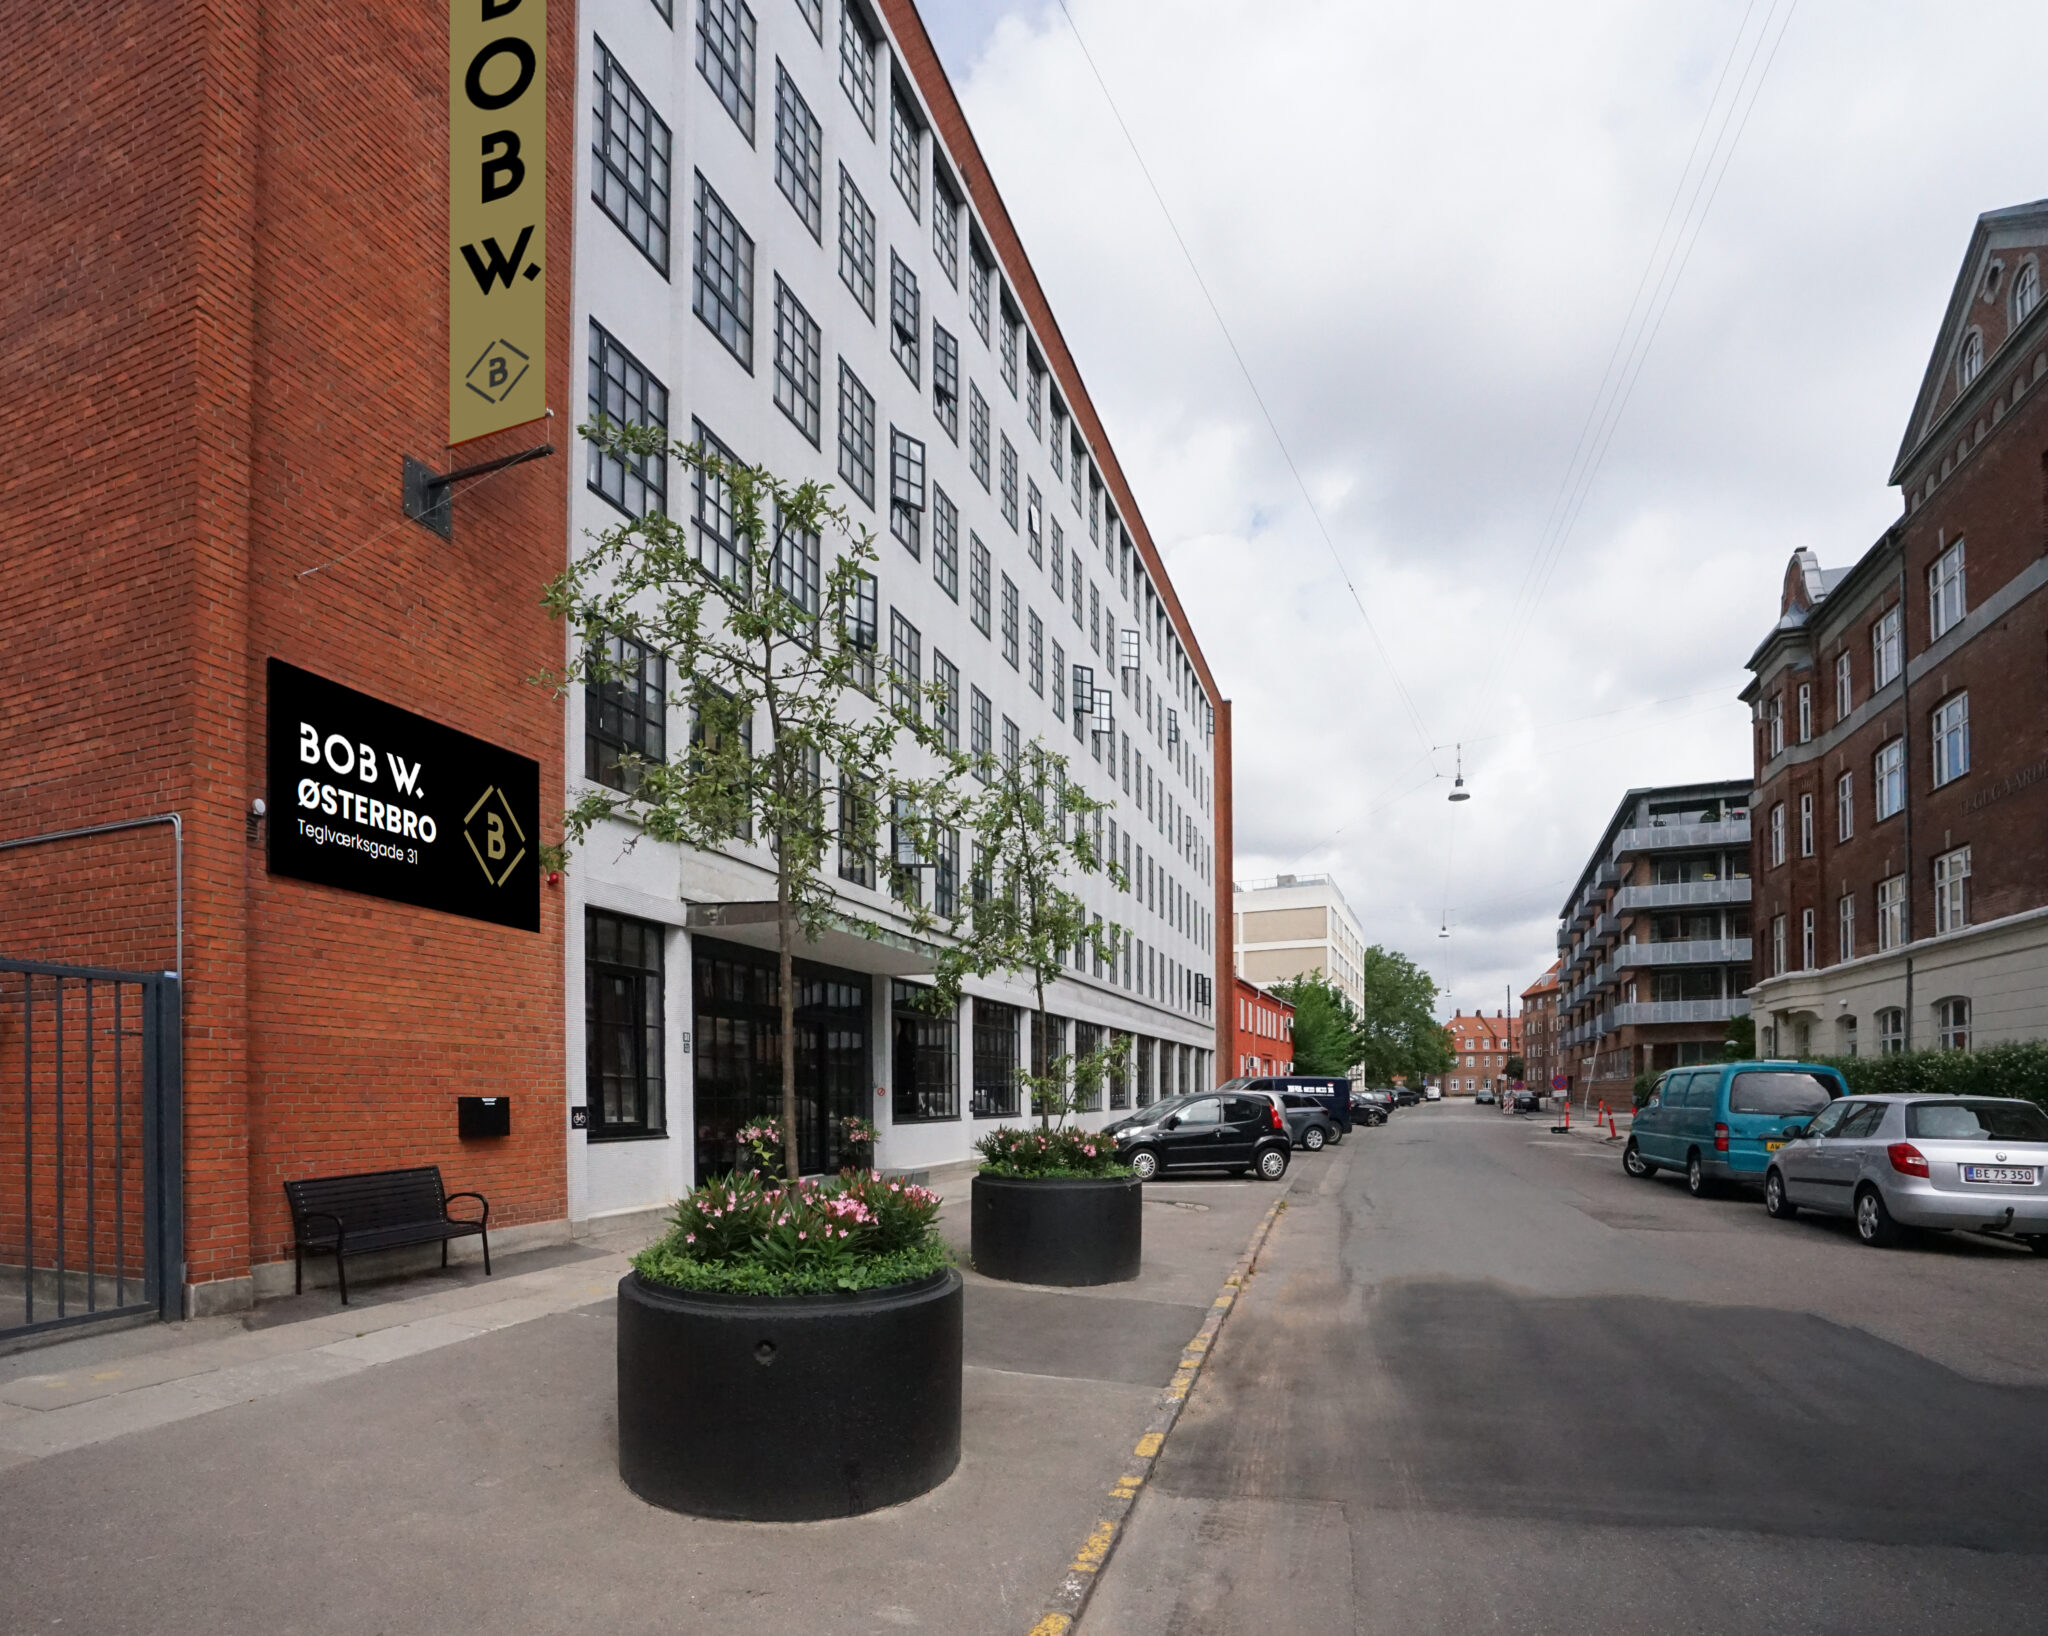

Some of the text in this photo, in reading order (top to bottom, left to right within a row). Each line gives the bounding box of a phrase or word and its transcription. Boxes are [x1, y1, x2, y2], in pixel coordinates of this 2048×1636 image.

[300, 721, 424, 799] BOB W.
[297, 778, 437, 844] ØSTERBRO
[487, 811, 506, 860] B
[297, 818, 418, 864] Teglværksgade 31
[1975, 1169, 2032, 1180] BE 75 350
